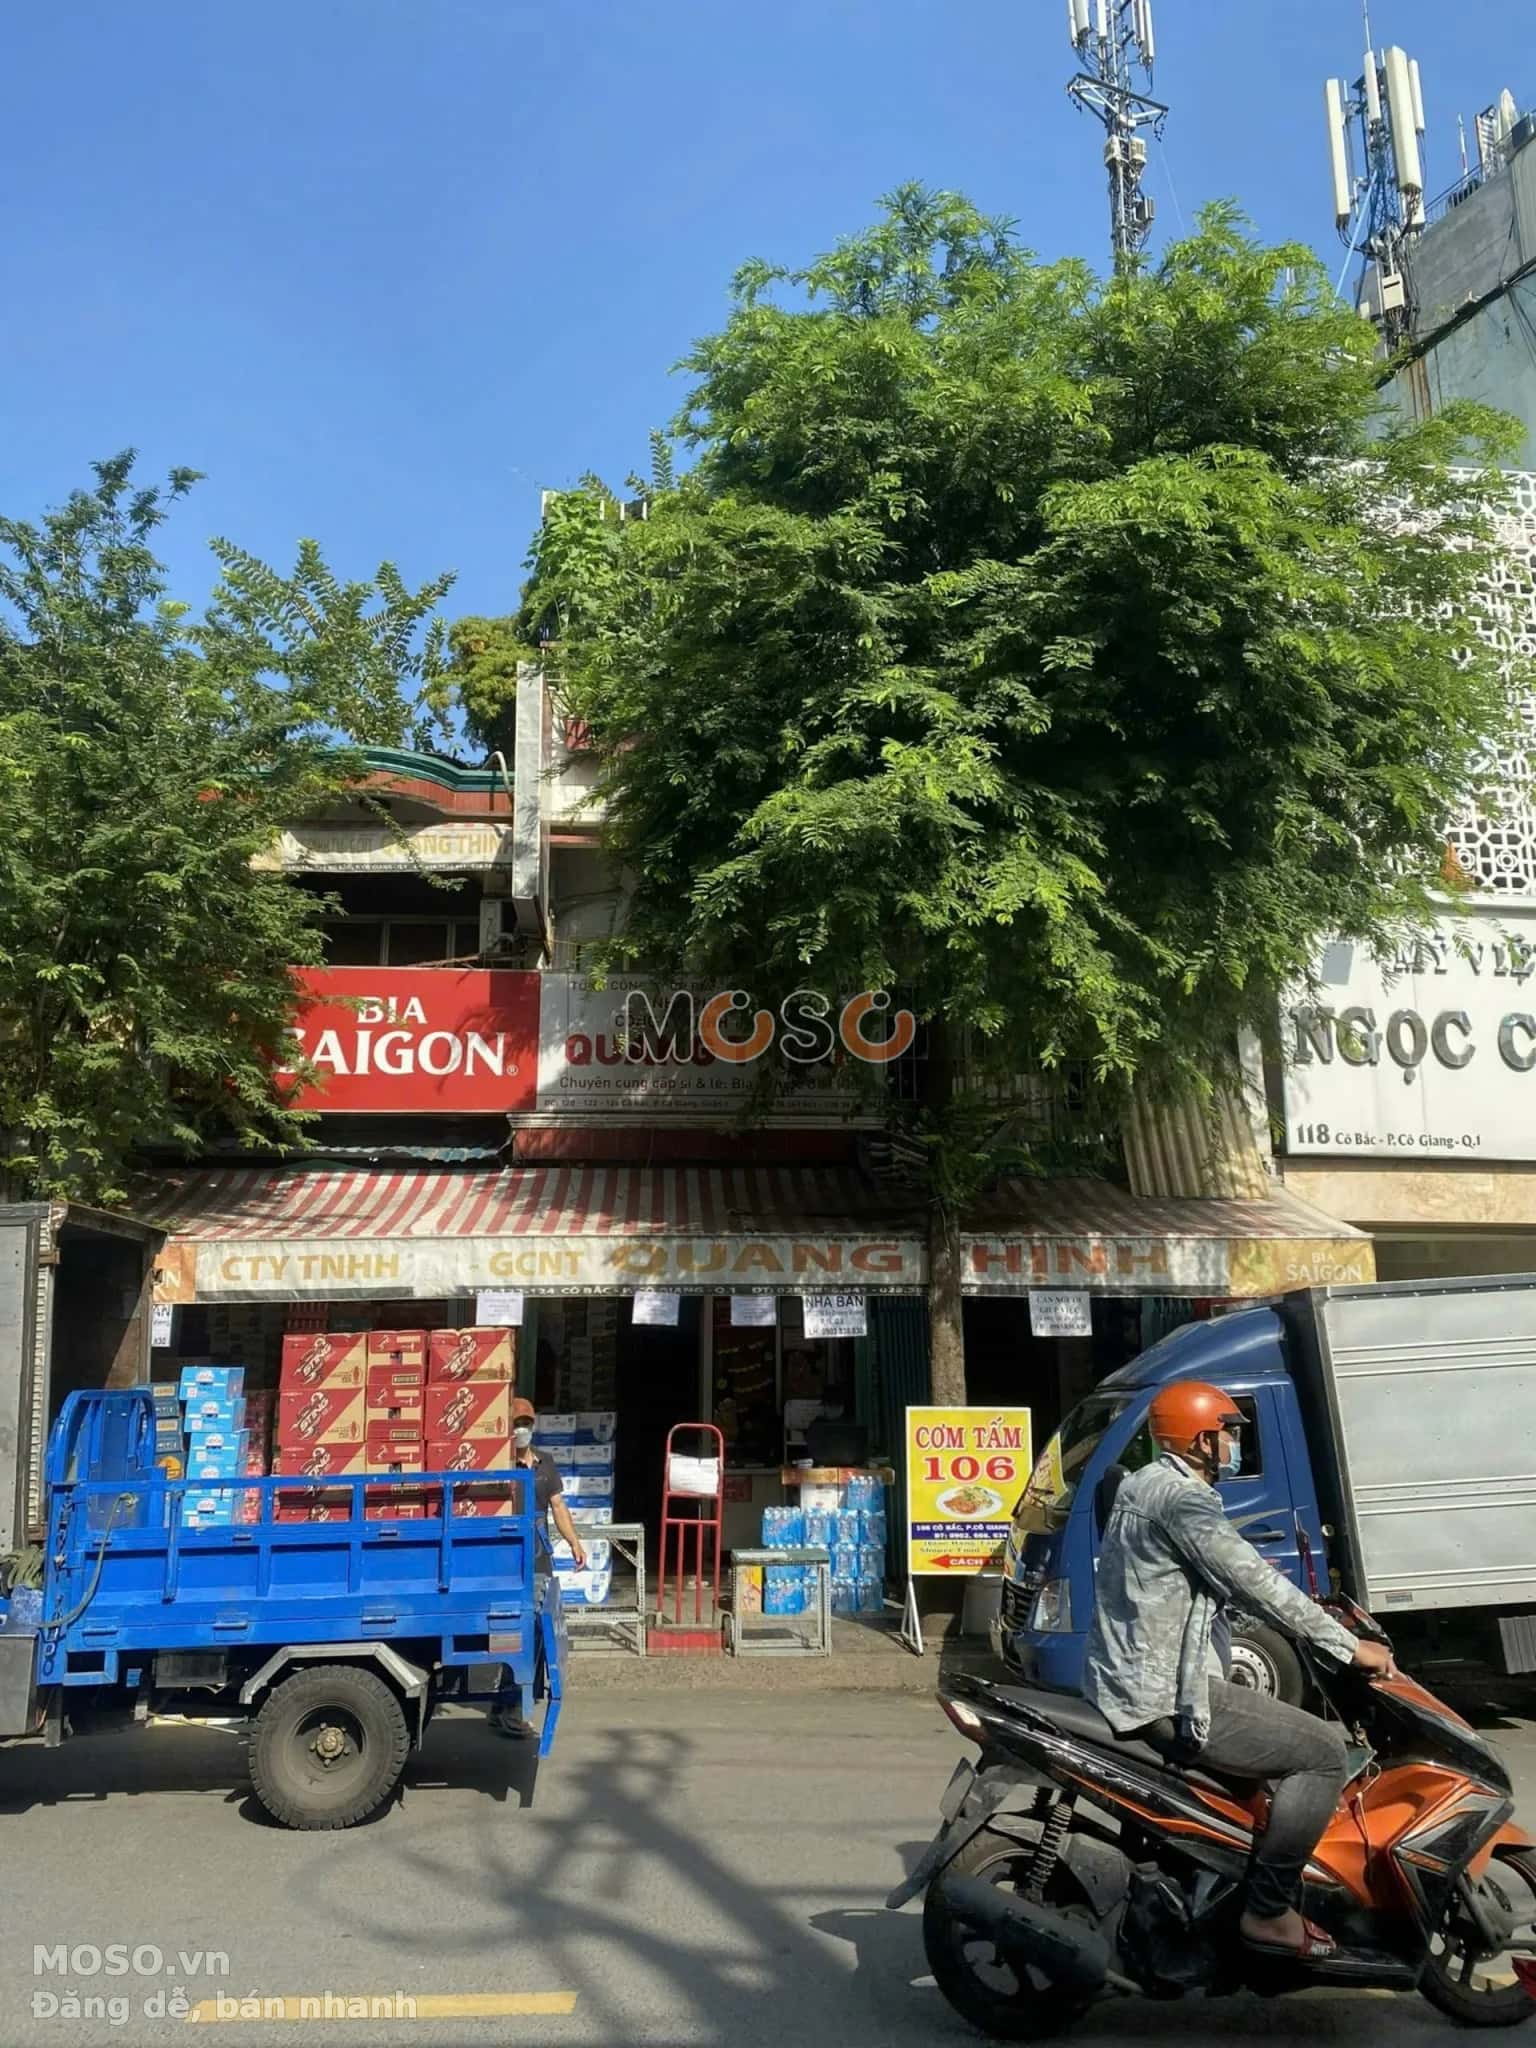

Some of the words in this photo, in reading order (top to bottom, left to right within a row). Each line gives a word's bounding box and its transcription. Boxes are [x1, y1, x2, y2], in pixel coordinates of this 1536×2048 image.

[357, 996, 428, 1024] BIA
[1290, 1005, 1476, 1086] NGỌC
[1296, 1123, 1331, 1145] 118
[220, 1256, 291, 1281] CTY
[298, 1253, 399, 1280] TNHH
[488, 1250, 586, 1276] GCNT
[610, 1243, 903, 1274] QUANG
[1311, 1252, 1335, 1263] BIA
[1286, 1263, 1362, 1282] SAIGON
[915, 1423, 965, 1449] CƠM
[973, 1416, 1022, 1449] TẤM
[924, 1456, 1016, 1481] 106
